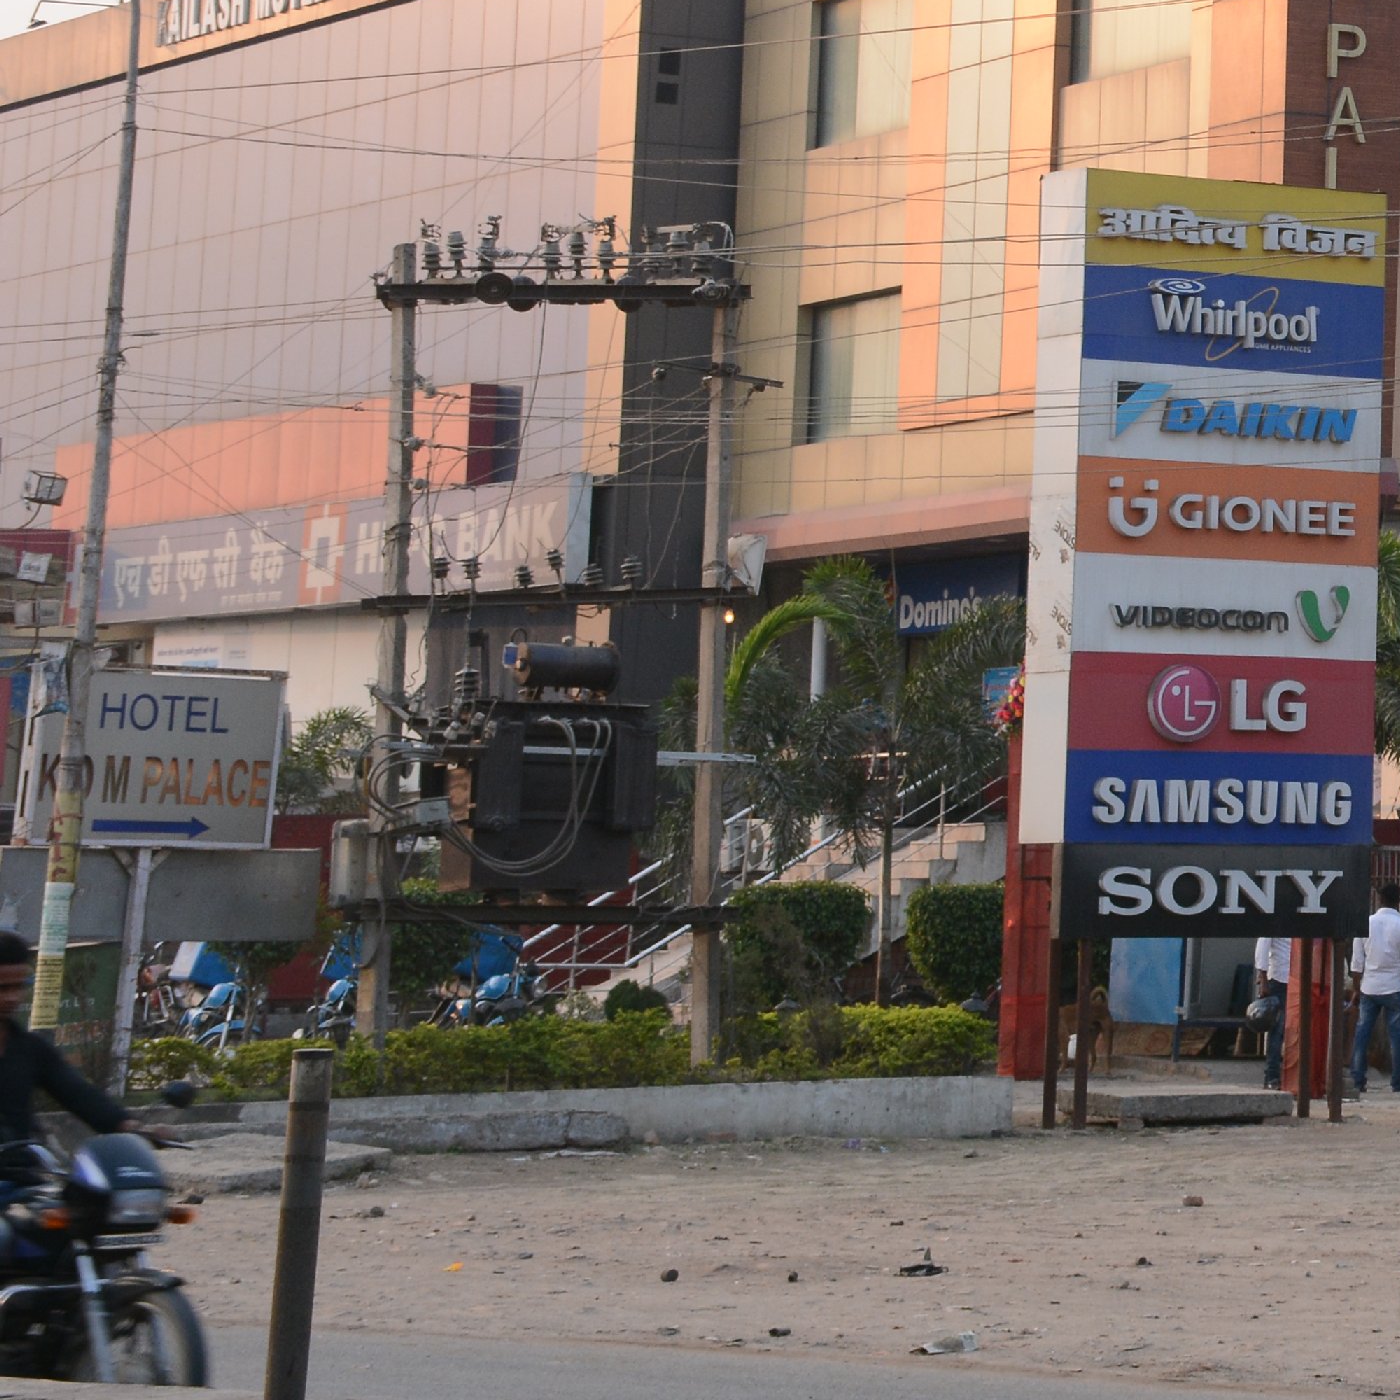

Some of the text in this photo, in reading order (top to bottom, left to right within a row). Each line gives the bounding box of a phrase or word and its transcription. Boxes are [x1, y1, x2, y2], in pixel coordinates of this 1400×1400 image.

[1151, 292, 1319, 350] Whirlpool
[1160, 395, 1358, 444] DAIKIN
[355, 501, 559, 576] HFC BANK
[1169, 491, 1357, 539] GIONEE
[114, 556, 141, 609] एच
[147, 535, 174, 594] डी
[213, 527, 242, 588] सी
[99, 692, 229, 734] HOTEL
[1230, 677, 1309, 733] LG
[139, 756, 273, 808] PALACE
[1092, 776, 1353, 828] SAMSUNG
[1097, 865, 1344, 918] SONY
